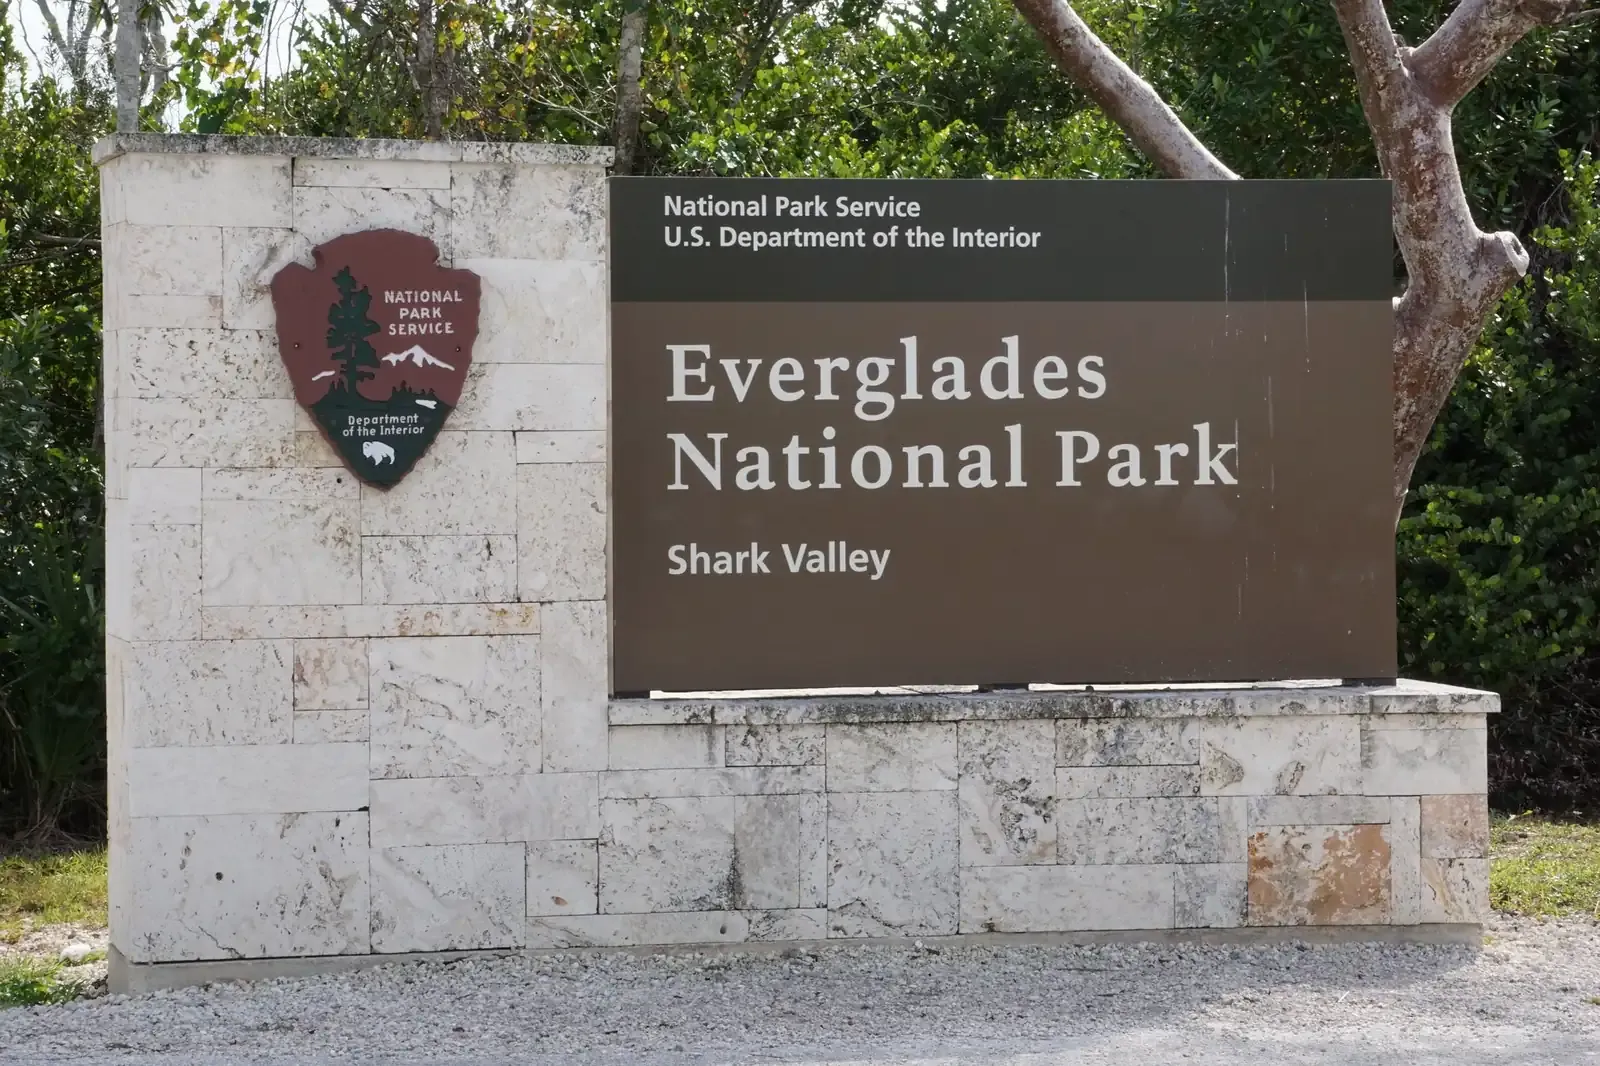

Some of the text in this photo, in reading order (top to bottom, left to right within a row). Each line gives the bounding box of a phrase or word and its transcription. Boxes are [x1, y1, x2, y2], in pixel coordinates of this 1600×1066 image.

[663, 194, 921, 218] National Park Service
[663, 225, 1042, 252] U.S. Department of the Interior
[384, 290, 463, 304] NATIONAL
[399, 306, 442, 320] PARK
[388, 321, 455, 336] SERVICE
[665, 334, 1108, 421] Everglades
[348, 413, 419, 426] Department
[342, 424, 425, 437] of the Interior
[666, 421, 1240, 492] National Park
[667, 540, 891, 582] Shark Valley
